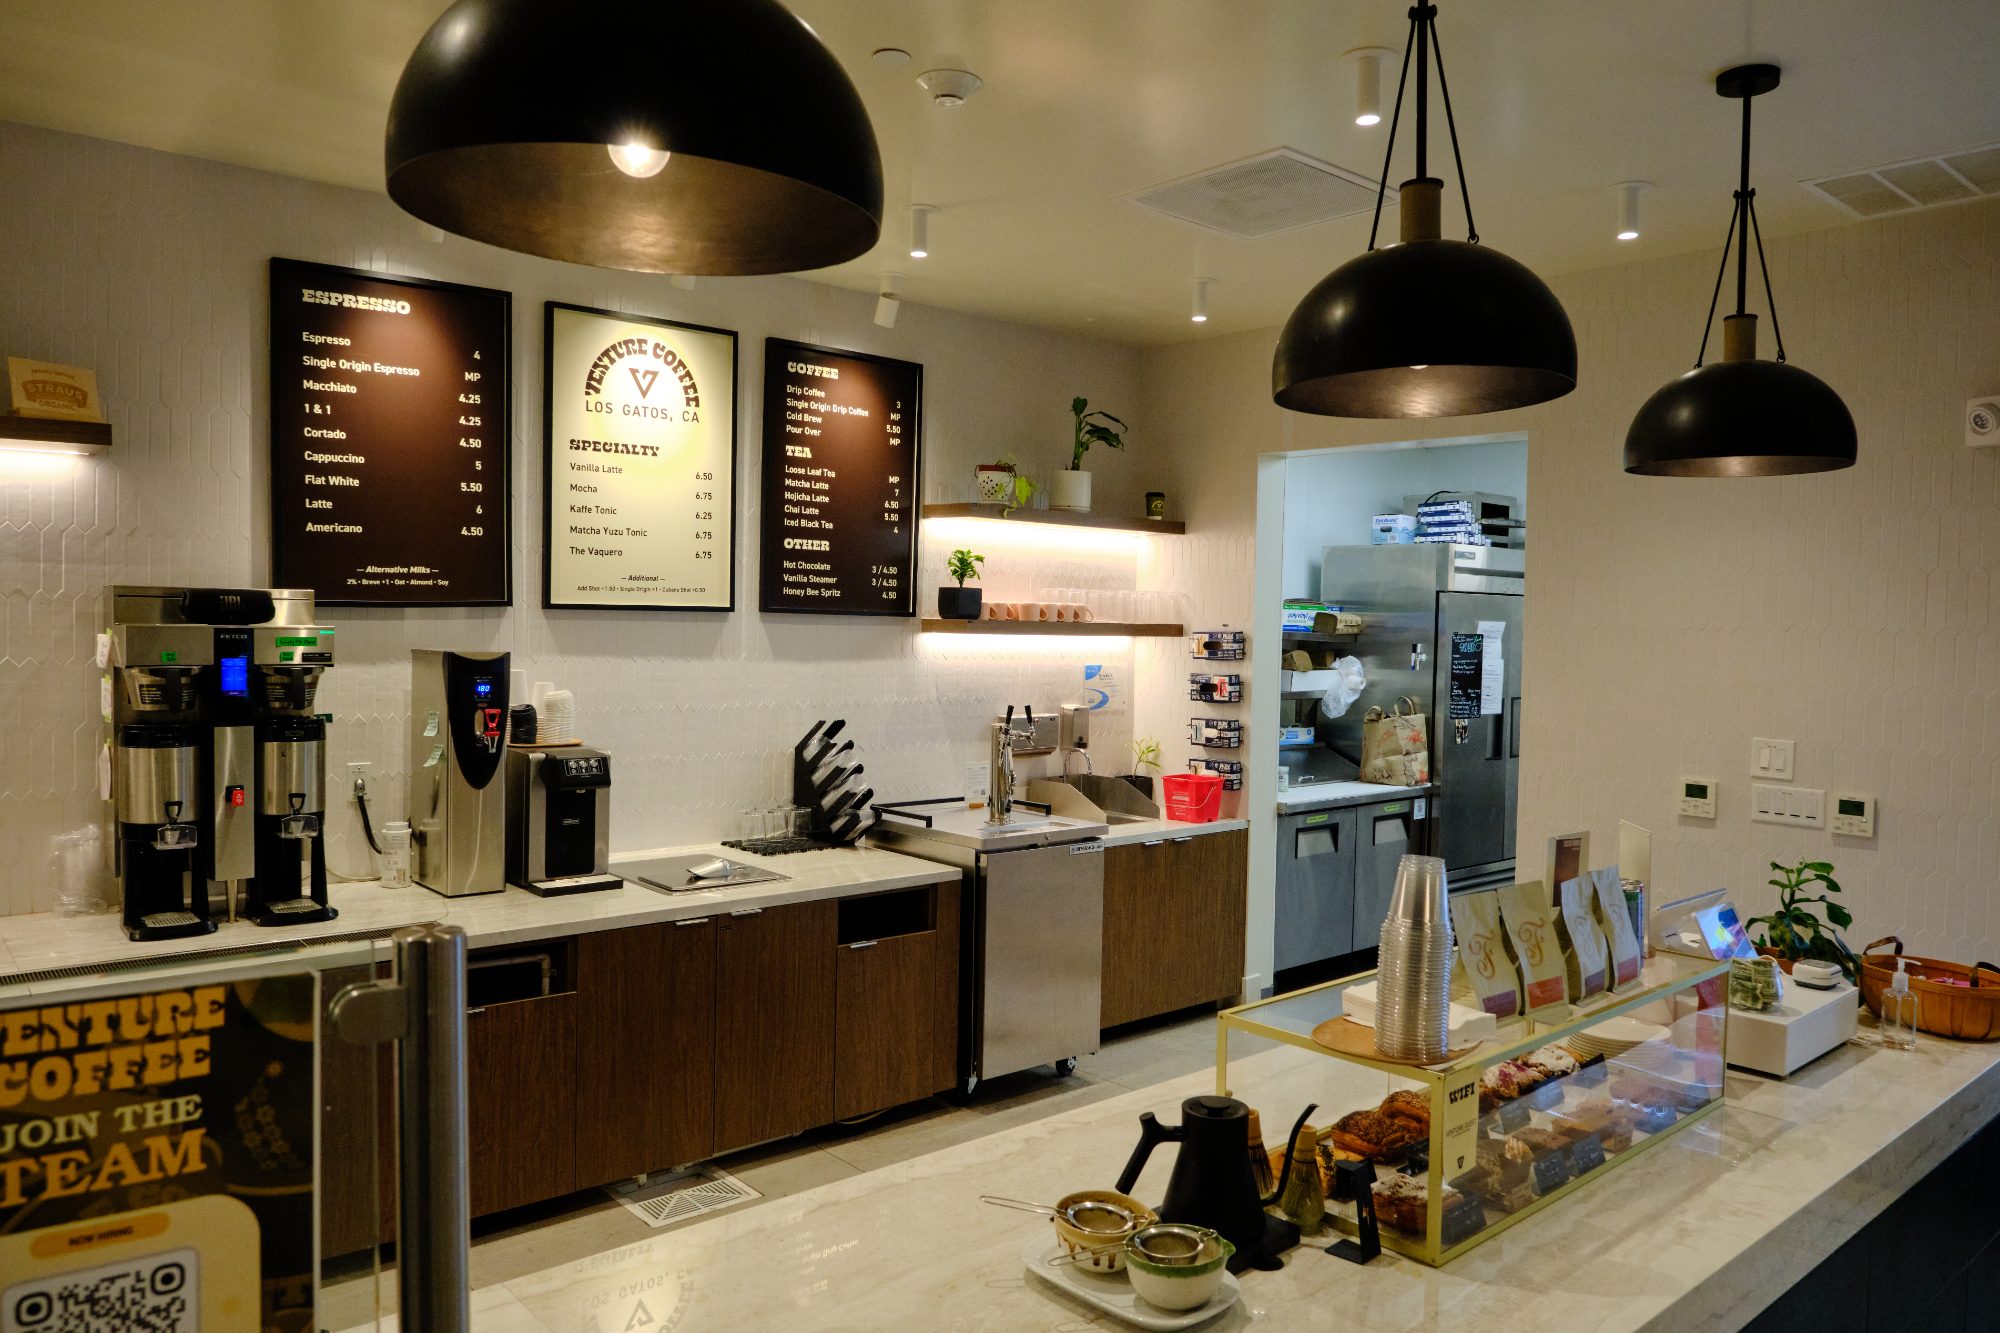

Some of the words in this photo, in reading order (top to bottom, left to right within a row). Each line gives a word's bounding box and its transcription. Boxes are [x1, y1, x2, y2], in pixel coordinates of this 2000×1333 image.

[302, 289, 410, 314] ESPRESSO
[302, 332, 350, 346] Espresso
[474, 351, 480, 359] 4
[303, 356, 336, 368] Single
[339, 360, 371, 372] Origin
[374, 363, 420, 376] Espresso
[465, 372, 480, 382] MP
[585, 339, 647, 396] VENTURE
[653, 342, 699, 408] COFFEE
[787, 362, 838, 379] COFFEE
[27, 384, 82, 400] STRAUS
[303, 380, 356, 393] Macchiato
[459, 394, 480, 404] 4.25
[787, 385, 802, 395] Drip
[804, 387, 825, 398] Coffee
[39, 400, 76, 411] ORGANIC
[586, 400, 613, 413] LOS
[623, 404, 673, 422] GATOS,
[682, 410, 699, 423] CA
[787, 398, 808, 409] Single
[810, 401, 830, 412] Origin
[833, 404, 846, 415] Drip
[849, 407, 868, 417] Coffee
[891, 413, 900, 421] MP
[304, 404, 309, 413] 1
[314, 405, 322, 414] &
[326, 406, 331, 414] 1
[459, 416, 481, 426] 4.25
[787, 412, 802, 421] Cold
[804, 414, 822, 424] Brew
[887, 425, 900, 433] 5.50
[304, 428, 346, 439] Cortado
[459, 439, 481, 448] 4.50
[786, 425, 803, 434] Pour
[805, 427, 821, 436] Over
[890, 438, 900, 446] MP
[570, 439, 659, 456] SPECIALTY
[786, 445, 812, 458] TEA
[304, 451, 364, 464] Cappuccino
[476, 461, 481, 470] 5
[570, 463, 599, 472] Vanilla
[602, 465, 622, 474] Latte
[786, 465, 805, 474] Loose
[807, 467, 822, 476] Leaf
[823, 469, 835, 477] Tea
[889, 476, 899, 484] MP
[305, 475, 325, 485] Flat
[328, 476, 359, 487] White
[461, 483, 482, 492] 5.50
[570, 484, 597, 493] Mocha
[696, 492, 712, 500] 6.75
[785, 478, 810, 488] Matcha
[812, 480, 829, 490] Latte
[306, 499, 332, 509] Latte
[476, 505, 482, 514] 6
[785, 492, 810, 502] Hojicha
[812, 494, 829, 502] Latte
[885, 501, 898, 509] 6.50
[570, 505, 592, 514] Kaffe
[595, 506, 617, 514] Tonic
[696, 512, 712, 520] 6.25
[785, 505, 800, 514] Chai
[802, 507, 819, 515] Latte
[306, 522, 362, 533] Americano
[461, 527, 483, 536] 4.50
[570, 526, 600, 535] Matcha
[603, 527, 623, 536] Yuzu
[626, 528, 647, 536] Tonic
[785, 518, 798, 526] Iced
[800, 519, 819, 528] Black
[821, 521, 833, 529] Tea
[570, 547, 585, 555] The
[588, 548, 622, 557] Vaquero
[695, 551, 712, 559] 6.75
[784, 538, 830, 551] OTHER
[366, 566, 408, 574] Alternative
[784, 561, 796, 569] Hot
[798, 562, 830, 570] Chocolate
[783, 574, 807, 582] Vanilla
[809, 575, 837, 584] Steamer
[872, 578, 876, 586] 3
[783, 587, 804, 596] Honey
[807, 588, 819, 596] Bee
[821, 589, 840, 597] Spritz
[0, 986, 226, 1057] ENTURE
[1449, 1082, 1475, 1104] WIFI
[0, 1111, 100, 1151] JOIN
[114, 1094, 203, 1133] THE
[0, 1127, 207, 1209] TEAM
